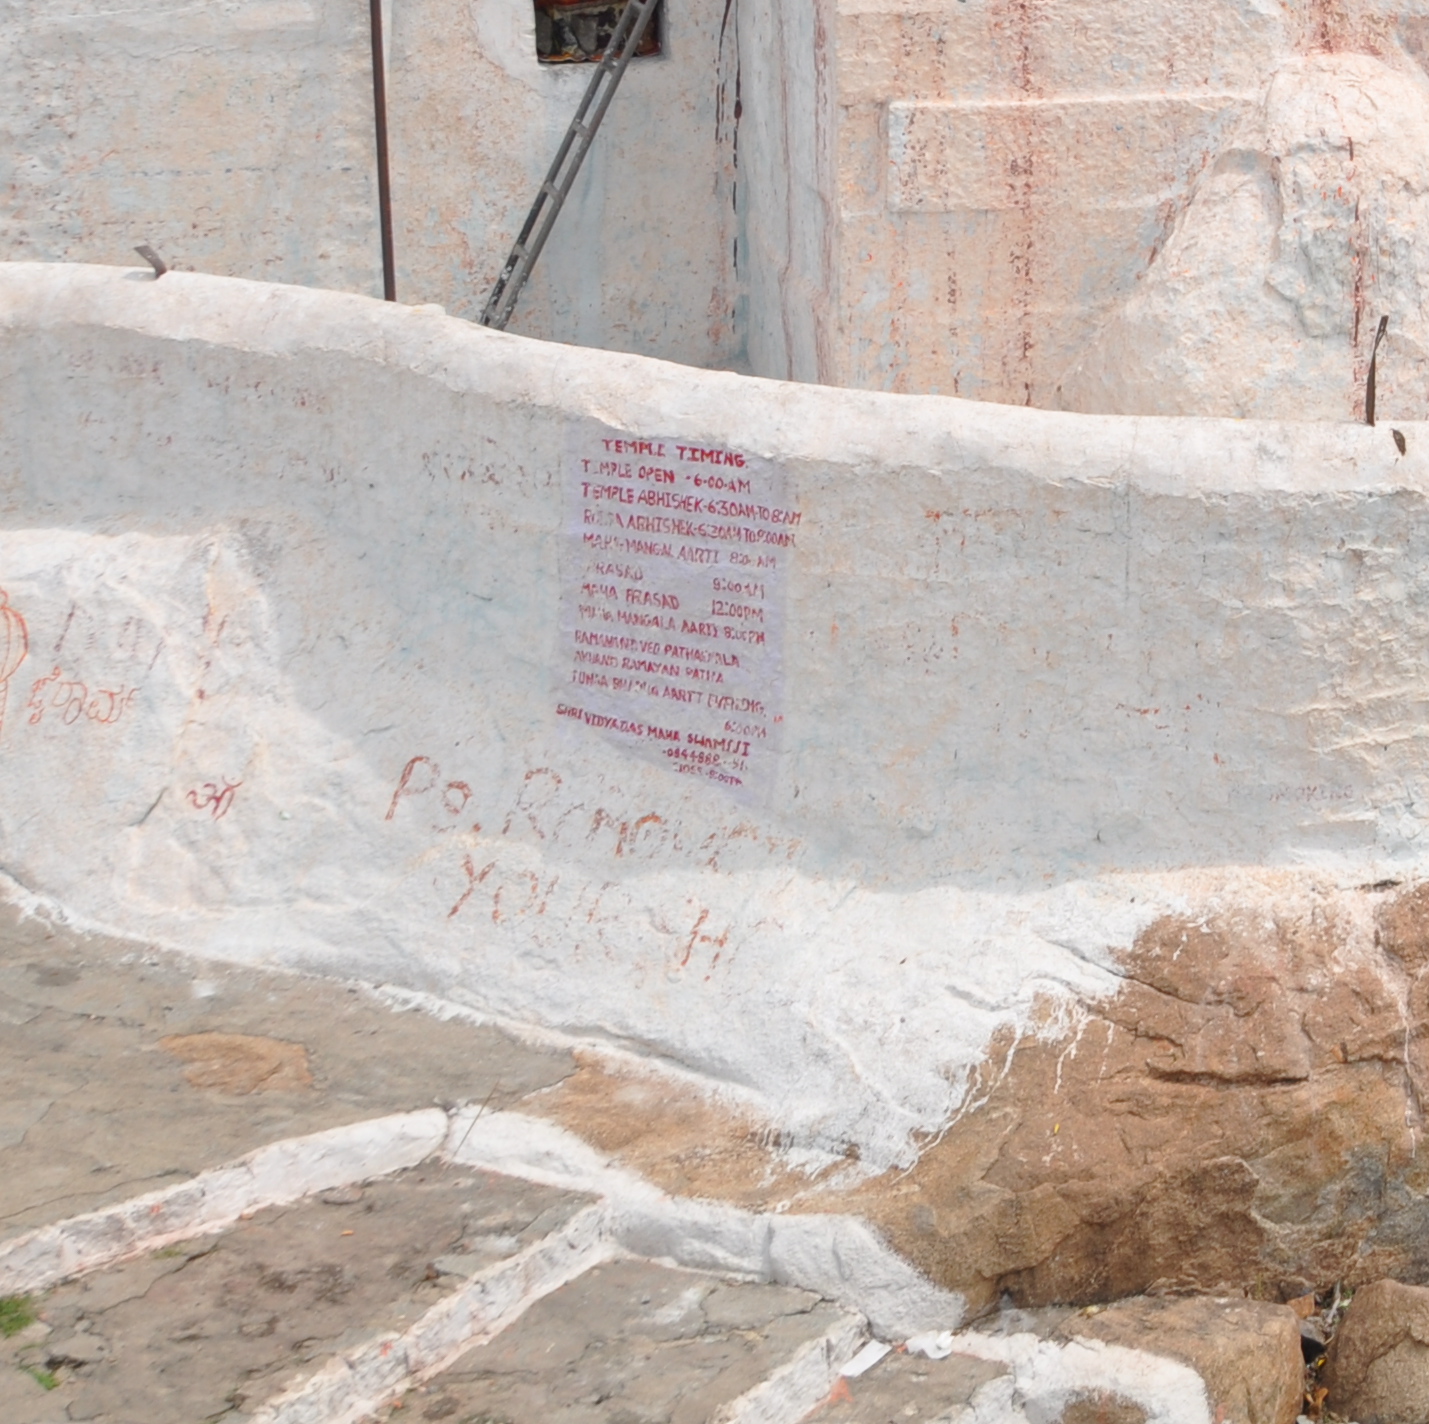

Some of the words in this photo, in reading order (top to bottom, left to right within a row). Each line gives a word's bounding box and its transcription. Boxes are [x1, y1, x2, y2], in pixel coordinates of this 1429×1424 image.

[601, 438, 666, 457] TEMPLE
[580, 459, 633, 479] TMPLE
[638, 465, 675, 483] OPEN
[580, 482, 635, 504] TEMPLE
[677, 545, 721, 564] AARTI
[625, 587, 681, 611] PRASAD
[621, 656, 681, 677] RAMAYAN
[646, 725, 681, 742] MAHA
